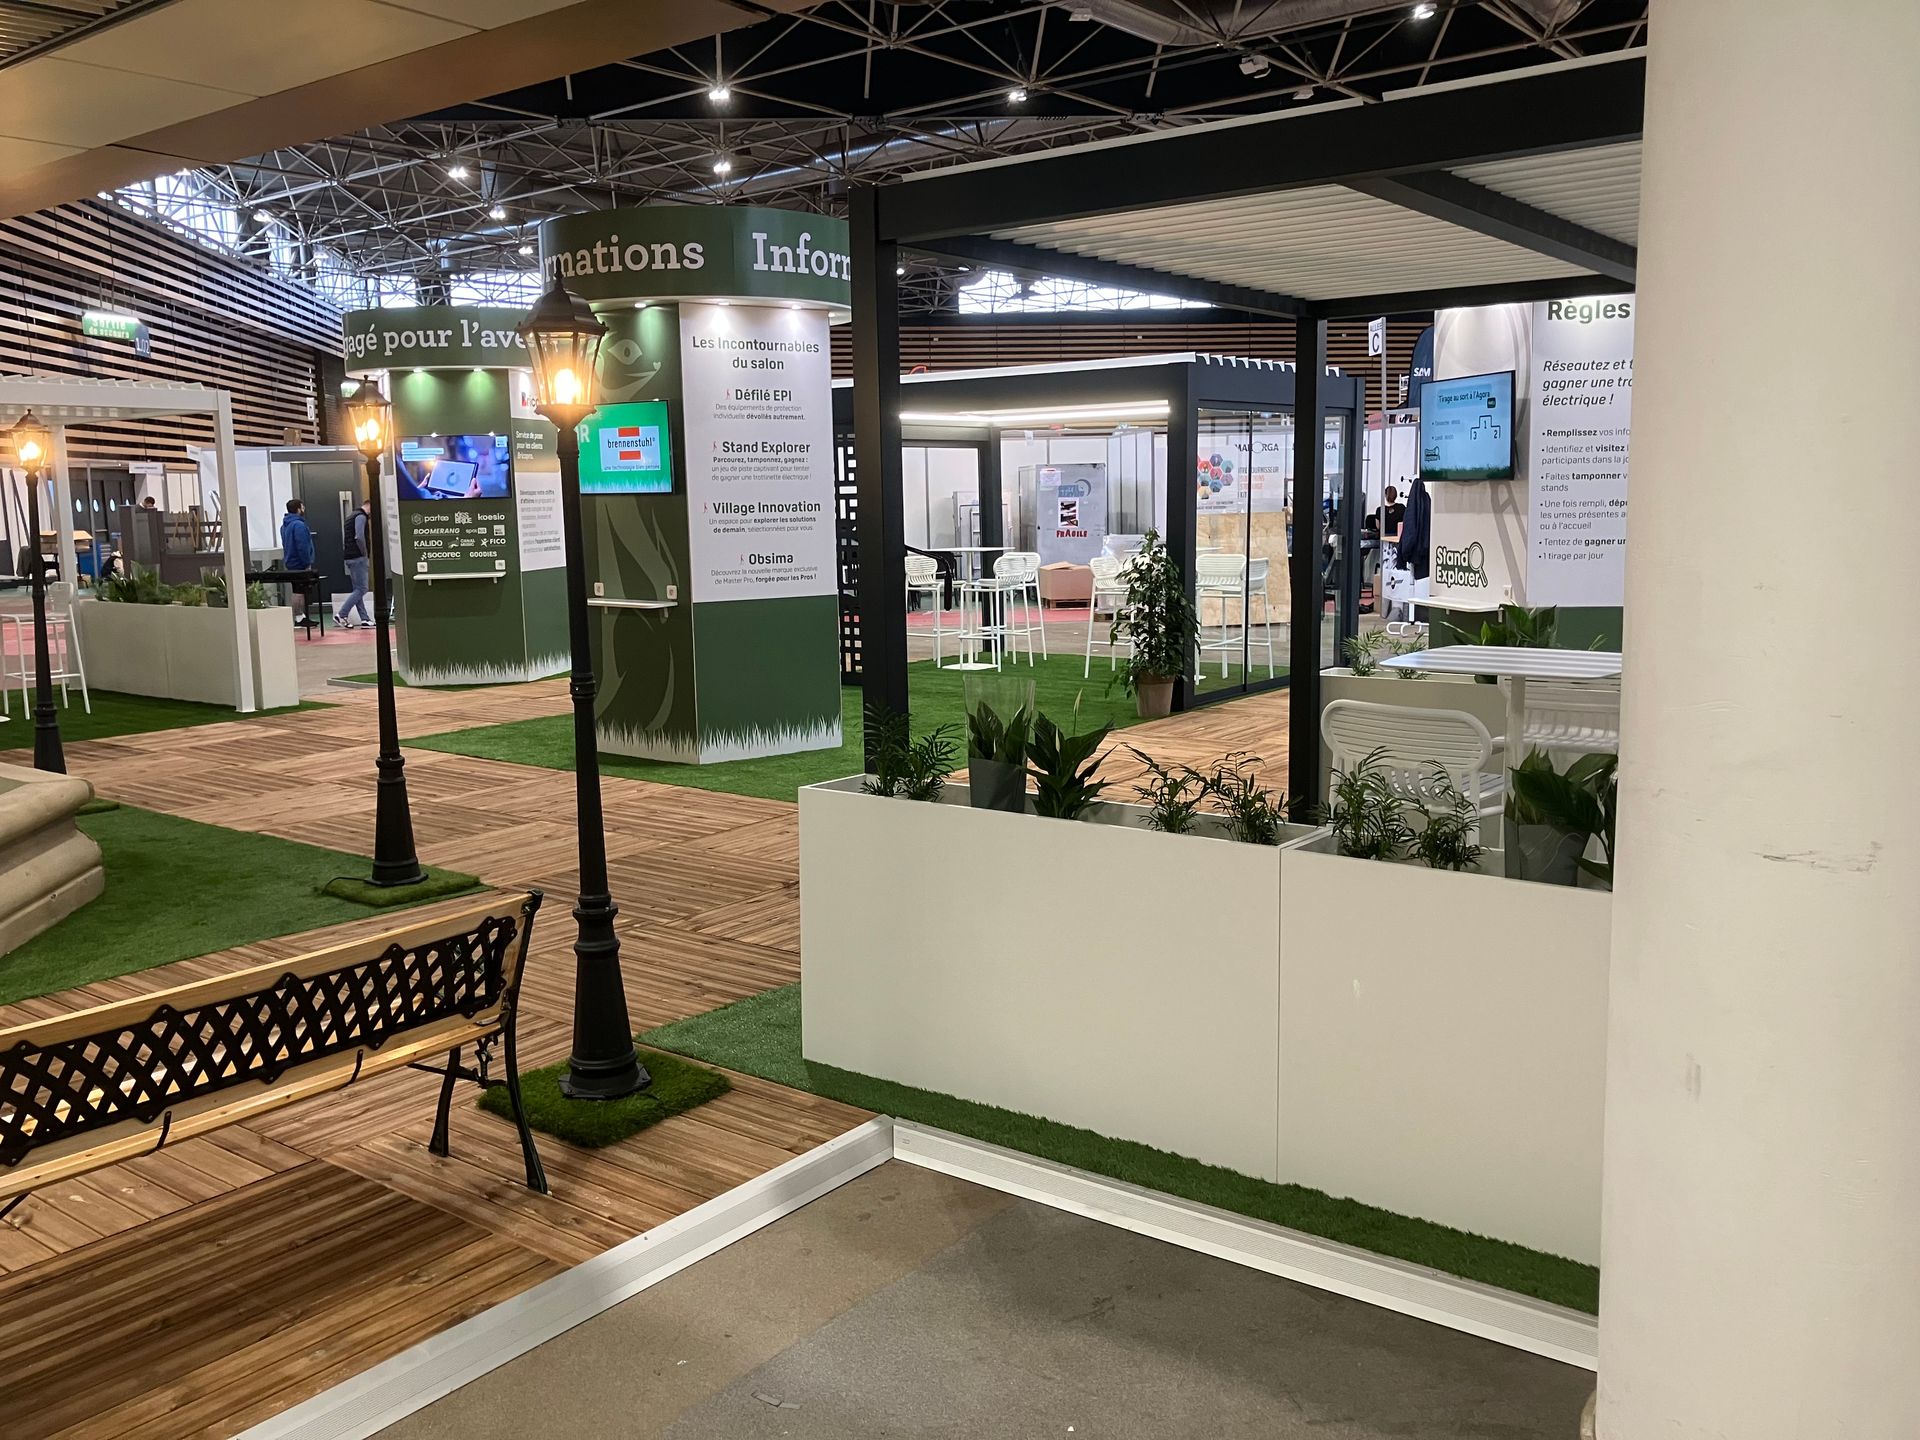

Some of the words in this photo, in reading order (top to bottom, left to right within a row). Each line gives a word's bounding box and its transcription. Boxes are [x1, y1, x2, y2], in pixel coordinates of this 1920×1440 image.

[1548, 300, 1631, 324] Règles
[383, 329, 452, 356] pour
[692, 336, 714, 348] Les
[718, 337, 820, 352] Incontournables
[1372, 332, 1380, 352] C
[732, 357, 748, 368] du
[751, 358, 784, 370] salon
[1543, 360, 1610, 372] Réseautez
[1613, 360, 1626, 370] et
[1414, 368, 1431, 376] SAM
[1542, 380, 1588, 392] gagner
[1590, 378, 1614, 388] une
[735, 389, 770, 400] Défilé
[774, 390, 792, 401] EPI
[1439, 395, 1453, 404] Tirage
[1542, 395, 1606, 408] électrique
[728, 404, 765, 412] équipements
[1484, 420, 1487, 429] 1
[1473, 431, 1478, 440] 3
[1494, 430, 1498, 439] 2
[1546, 428, 1598, 438] Remplissez
[722, 441, 758, 452] Stand
[761, 442, 810, 454] Explorer
[1546, 445, 1583, 453] Identifiez
[1596, 444, 1625, 452] visitez
[1542, 456, 1590, 466] participants
[1592, 456, 1612, 464] dans
[1572, 472, 1621, 480] tamponner
[712, 502, 755, 516] Village
[758, 501, 821, 513] Innovation
[1579, 500, 1606, 508] rempli,
[1578, 510, 1618, 519] présentes
[1559, 522, 1592, 530] l'accueil
[1056, 530, 1088, 538] FRAGILE
[1572, 538, 1582, 546] de
[1584, 538, 1616, 546] gagner
[748, 553, 794, 564] Obsima
[1436, 546, 1469, 566] Stand
[1548, 552, 1572, 560] tirage
[1588, 552, 1604, 560] jour
[1436, 566, 1480, 588] Explorer
